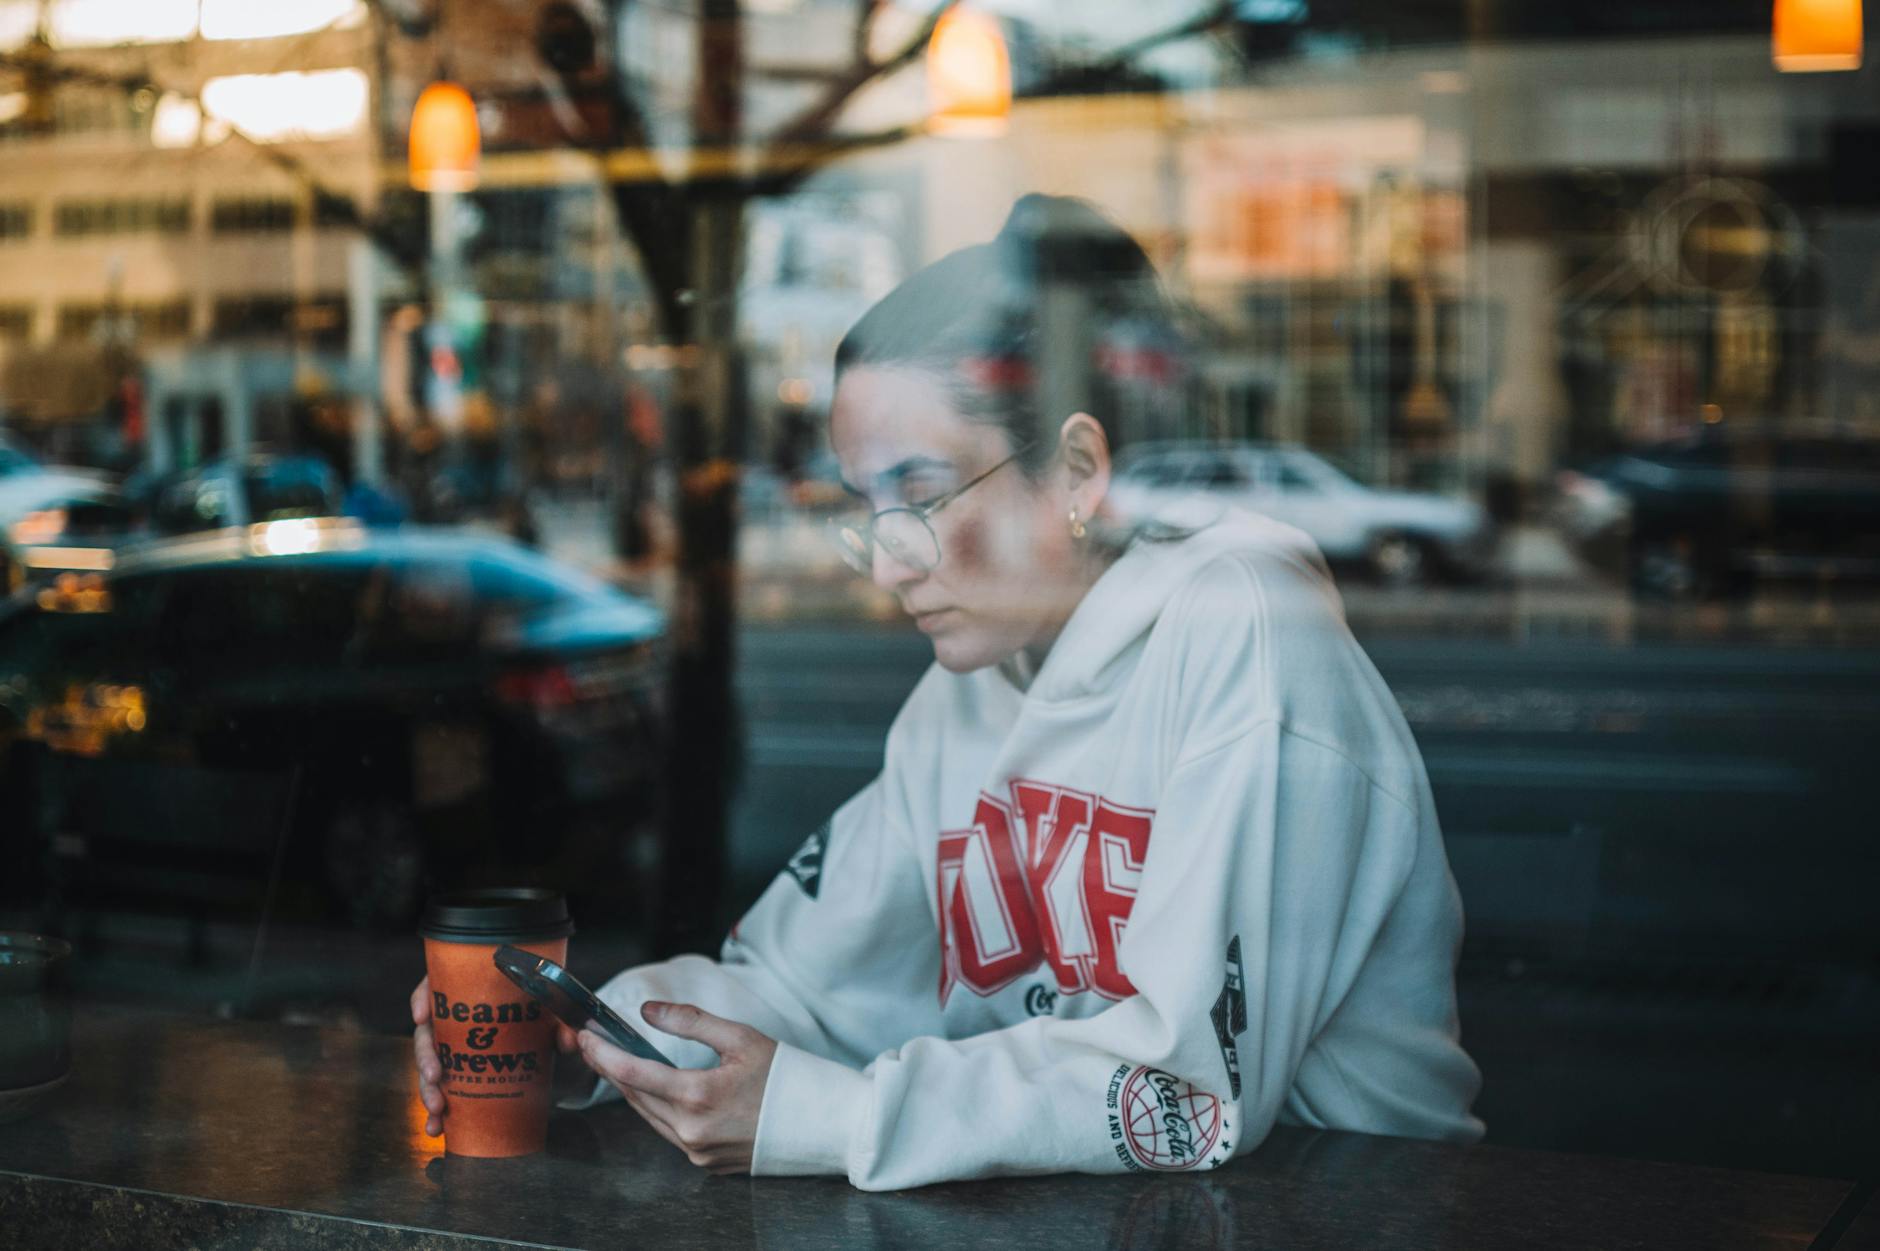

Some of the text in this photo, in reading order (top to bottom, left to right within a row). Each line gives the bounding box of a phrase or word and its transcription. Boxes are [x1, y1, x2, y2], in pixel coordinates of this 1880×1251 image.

[434, 992, 540, 1023] Beans
[466, 1028, 498, 1049] &
[439, 1044, 536, 1072] Brews
[1107, 1064, 1131, 1109] DELICIOUS
[1108, 1114, 1122, 1140] AND
